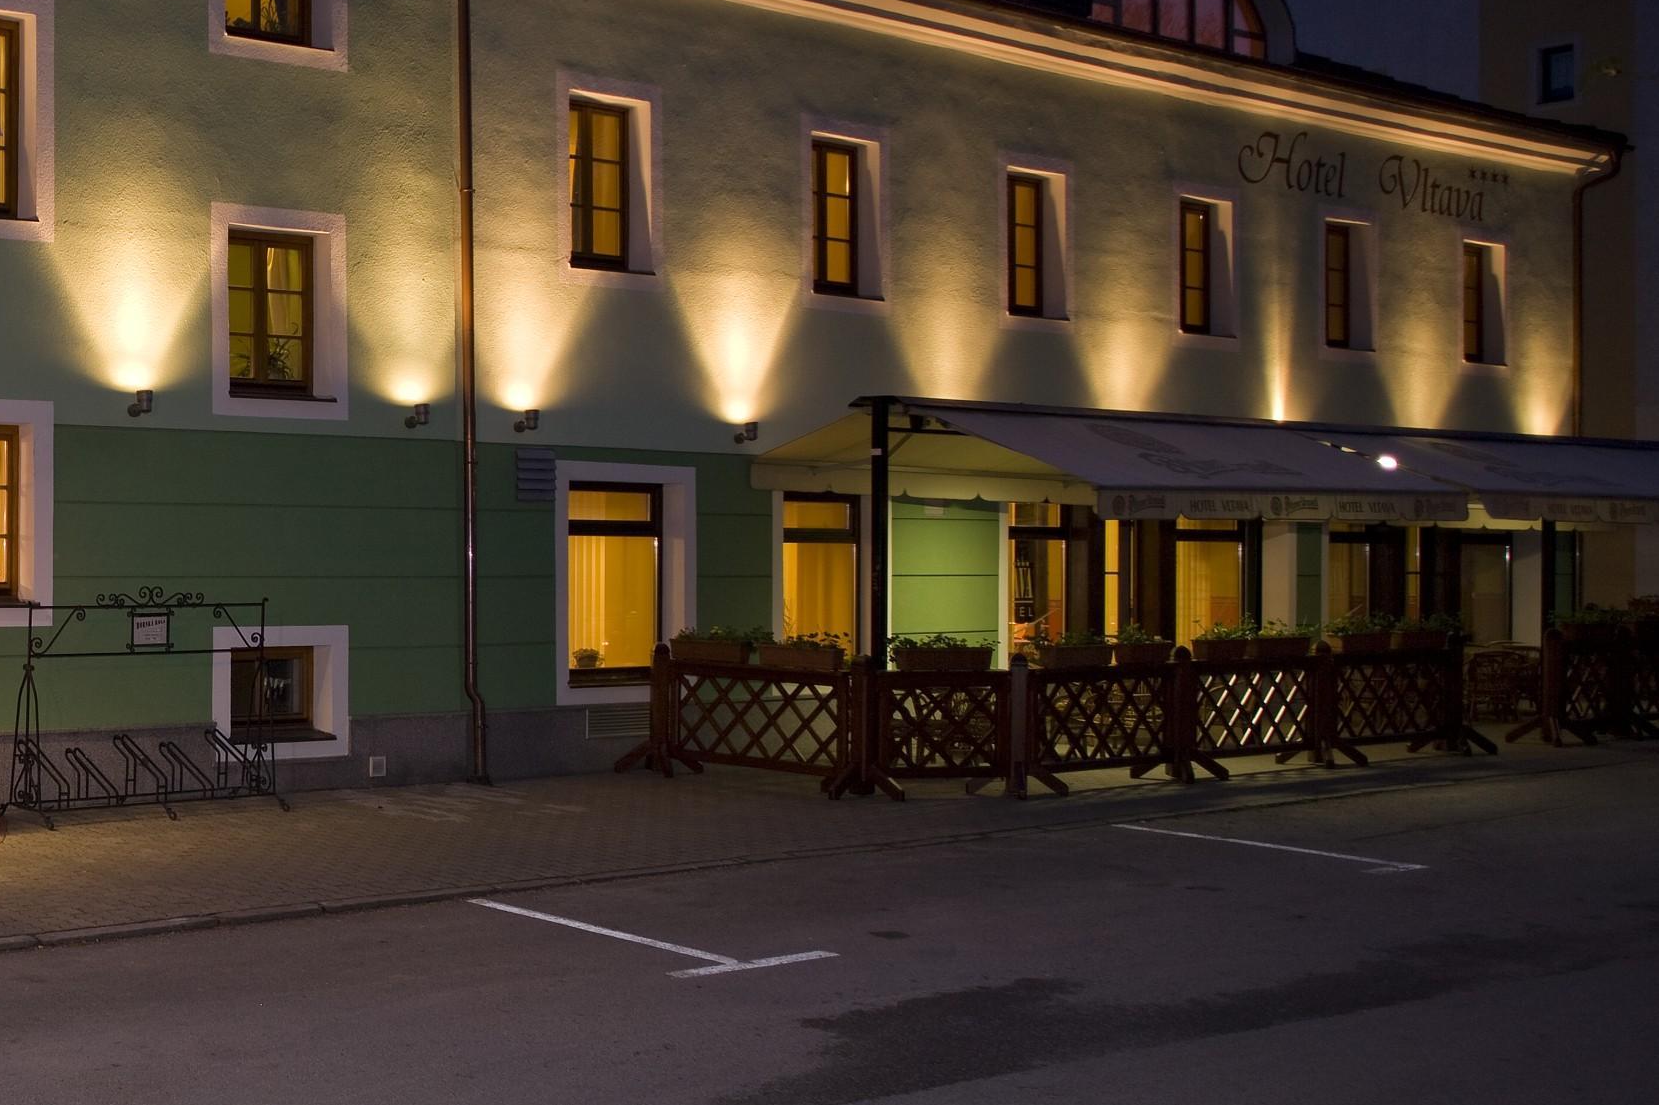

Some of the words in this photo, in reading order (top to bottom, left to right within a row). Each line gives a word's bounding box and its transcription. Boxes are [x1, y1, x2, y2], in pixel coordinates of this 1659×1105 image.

[1238, 132, 1347, 199] Hotel
[1379, 155, 1484, 222] Vltava
[1190, 499, 1217, 512] HOTEL
